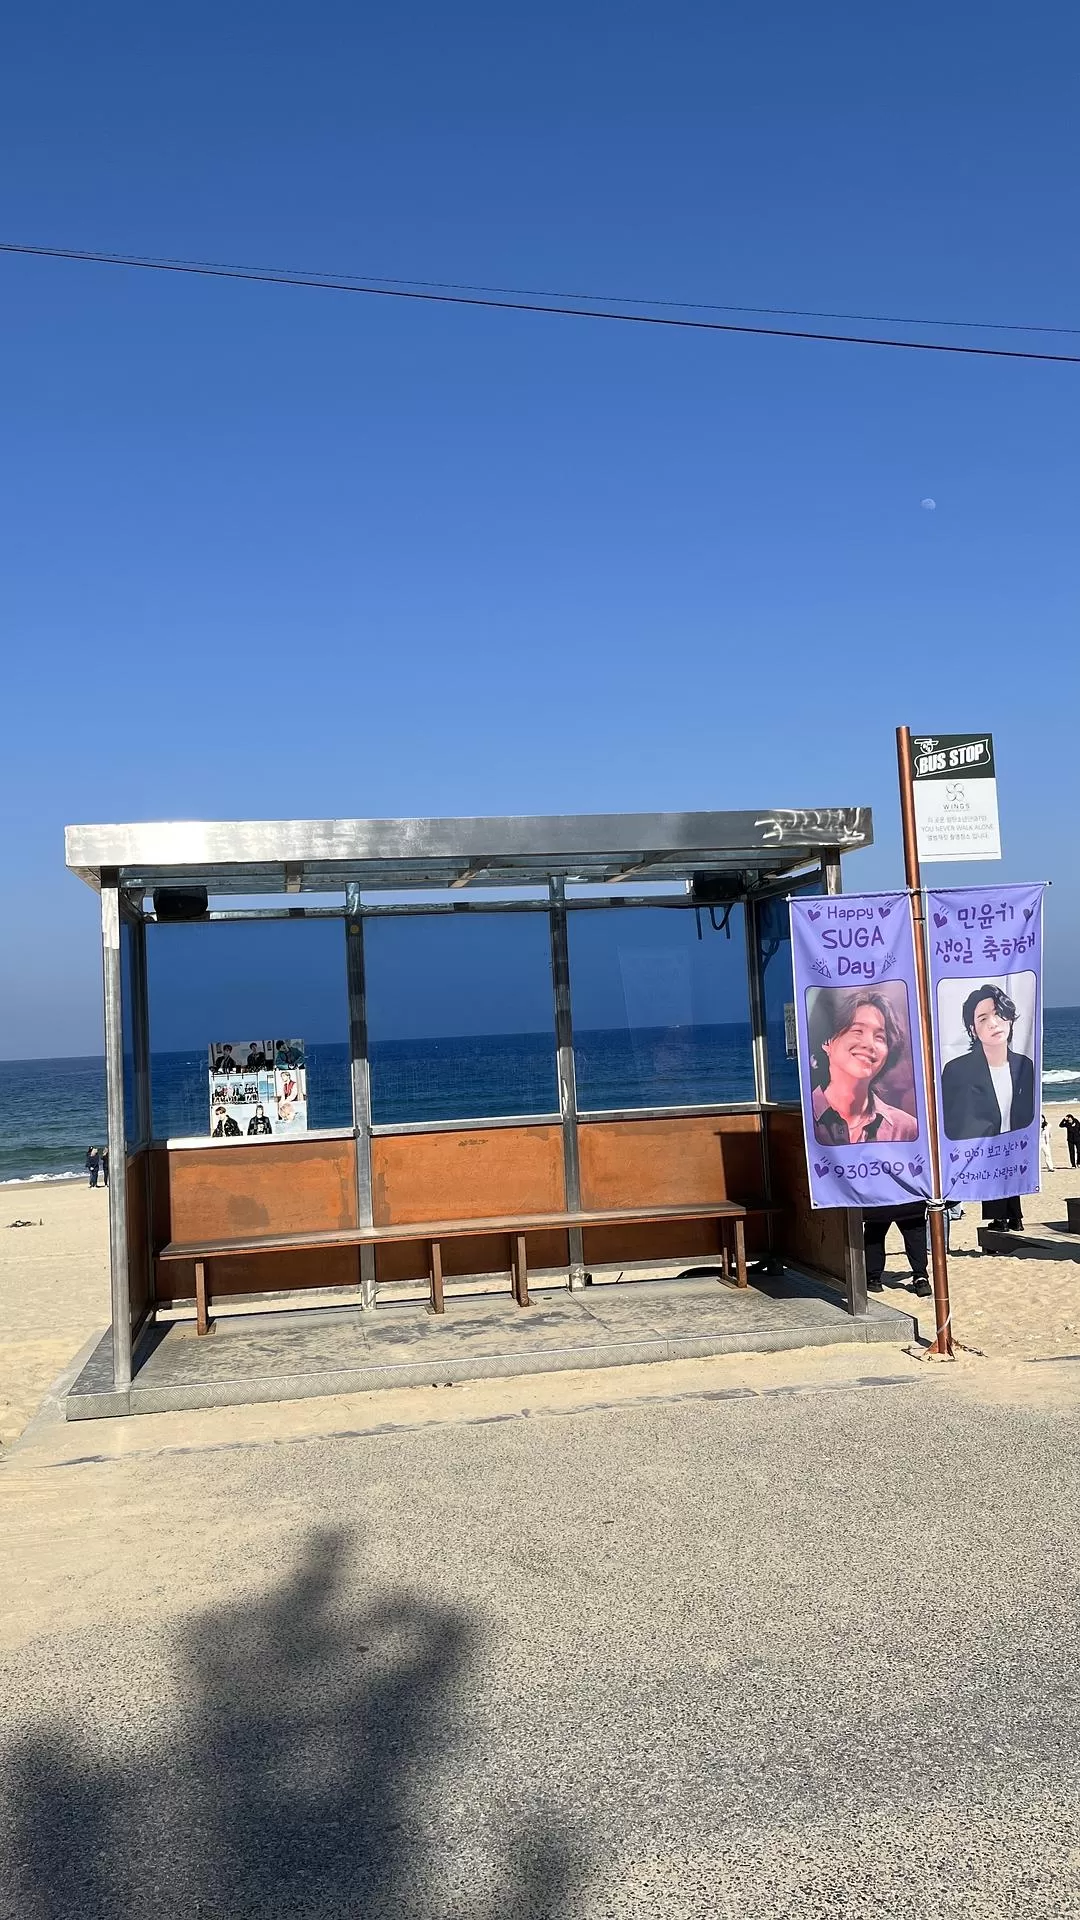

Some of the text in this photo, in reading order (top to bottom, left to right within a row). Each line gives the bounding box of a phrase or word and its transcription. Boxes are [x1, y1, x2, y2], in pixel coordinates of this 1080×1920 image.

[919, 743, 984, 775] BUS STOP
[921, 823, 993, 833] YOU NEVER WALK ALONE
[827, 905, 874, 921] Happy
[957, 902, 1014, 930] 민윤기
[821, 925, 885, 949] SUGA
[935, 932, 1035, 964] 생일 축하해
[837, 956, 875, 979] Day
[833, 1161, 905, 1179] 930309
[959, 1165, 1018, 1185] 언제나 사랑해
